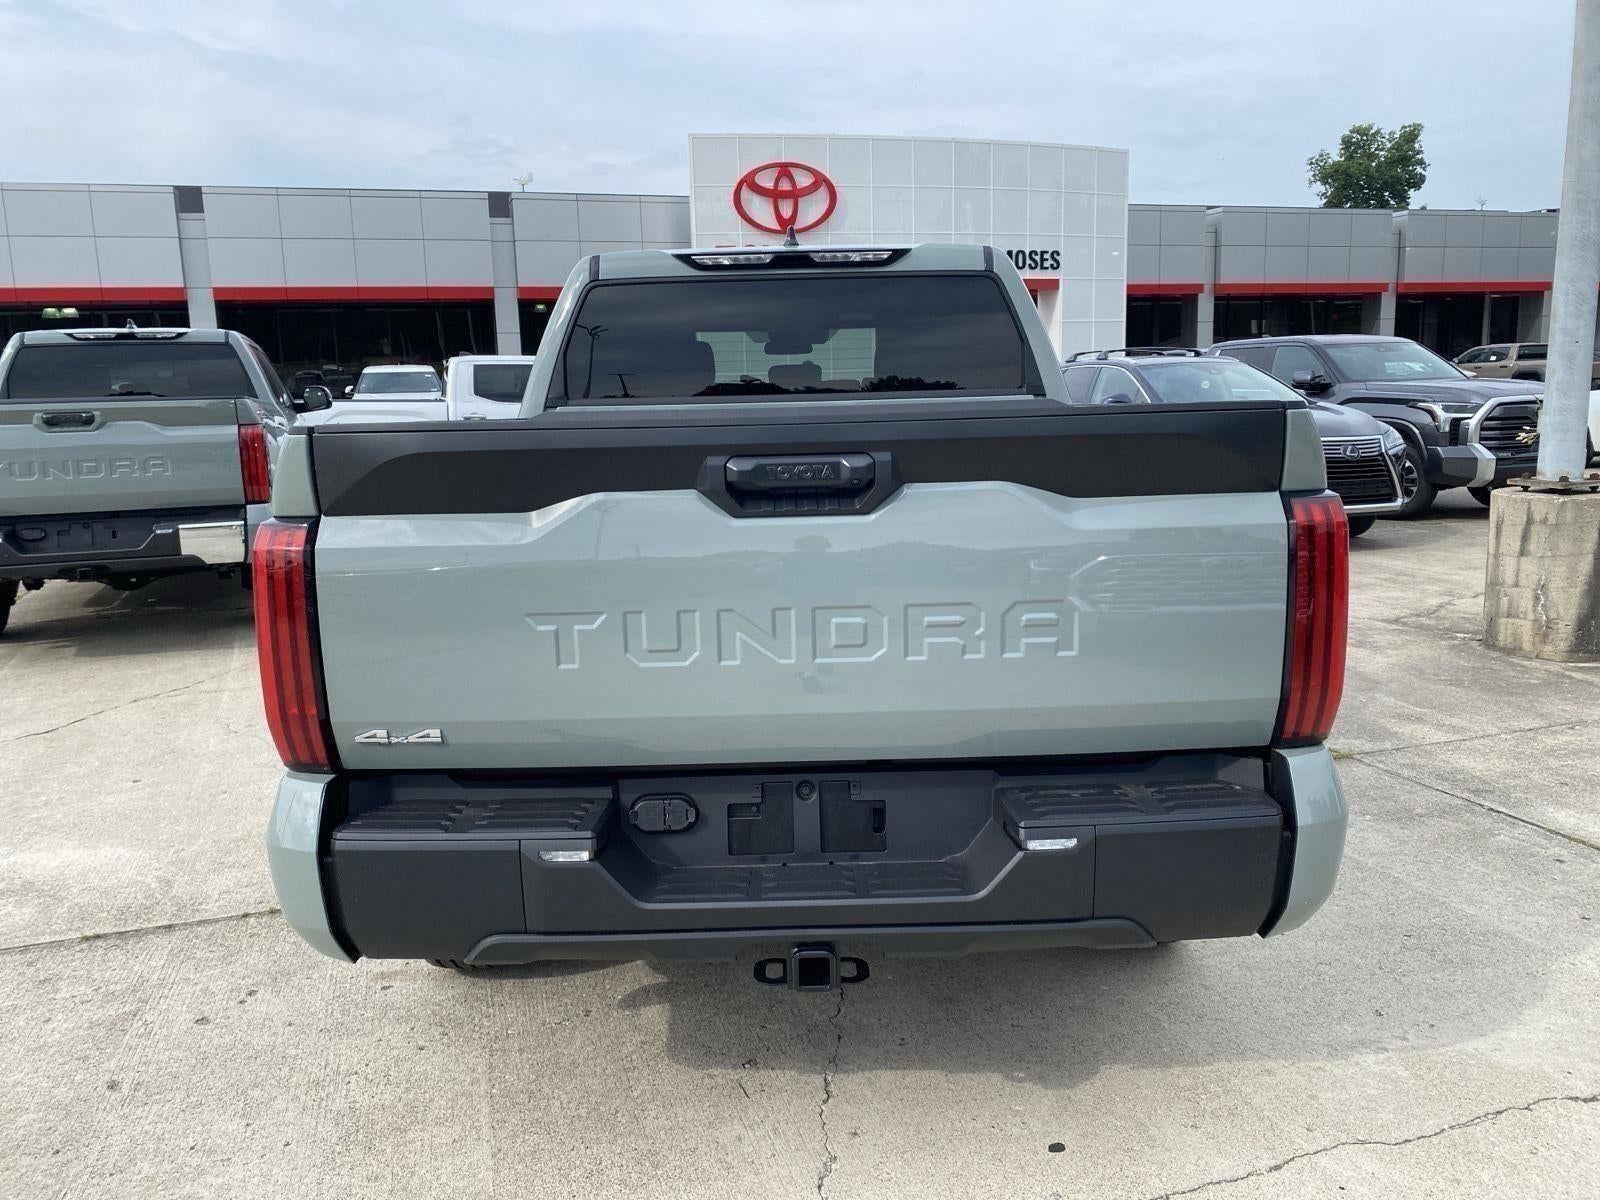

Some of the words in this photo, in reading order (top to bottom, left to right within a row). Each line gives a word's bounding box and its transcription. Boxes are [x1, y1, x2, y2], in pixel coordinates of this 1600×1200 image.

[0, 456, 172, 481] UNDRA
[766, 464, 834, 480] TOYOTA
[524, 599, 1080, 670] TUNDRA
